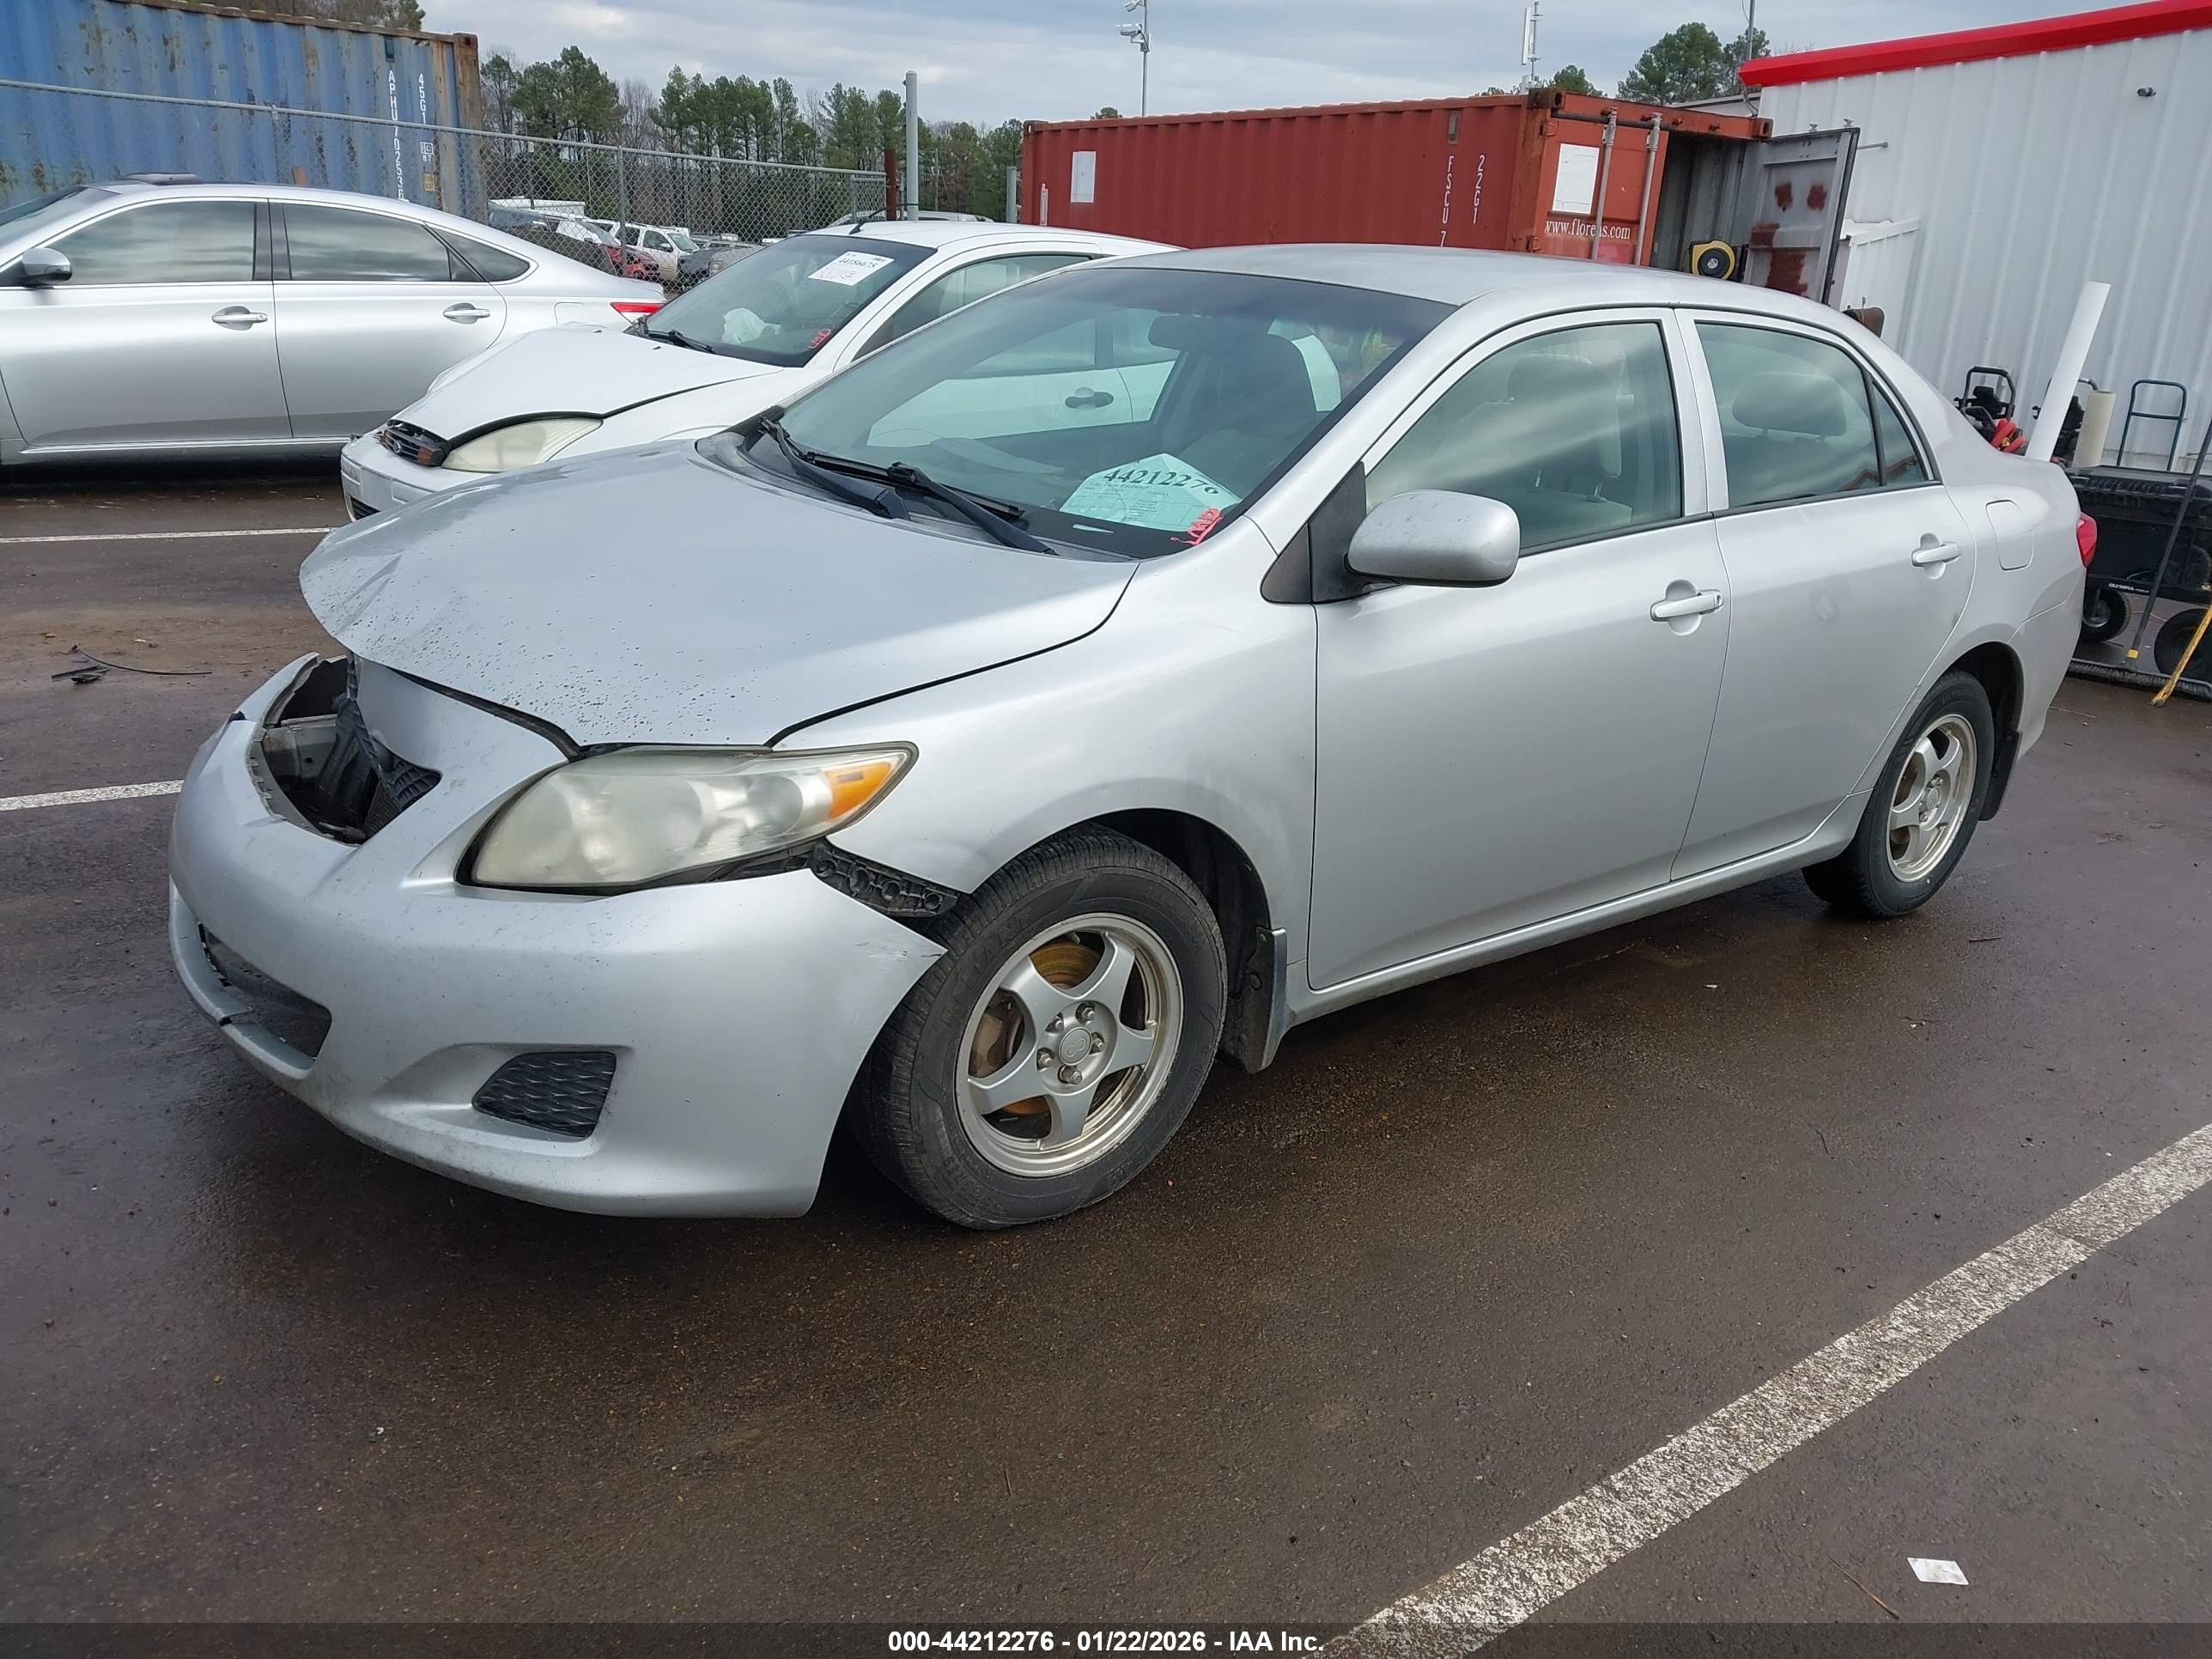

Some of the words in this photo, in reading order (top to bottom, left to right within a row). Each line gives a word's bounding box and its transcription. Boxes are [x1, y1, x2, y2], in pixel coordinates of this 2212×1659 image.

[388, 70, 398, 121] APHU
[418, 73, 427, 125] 45G1
[1442, 155, 1455, 224] FSCU
[1473, 154, 1486, 225] 22G1
[1103, 467, 1219, 495] 44212276
